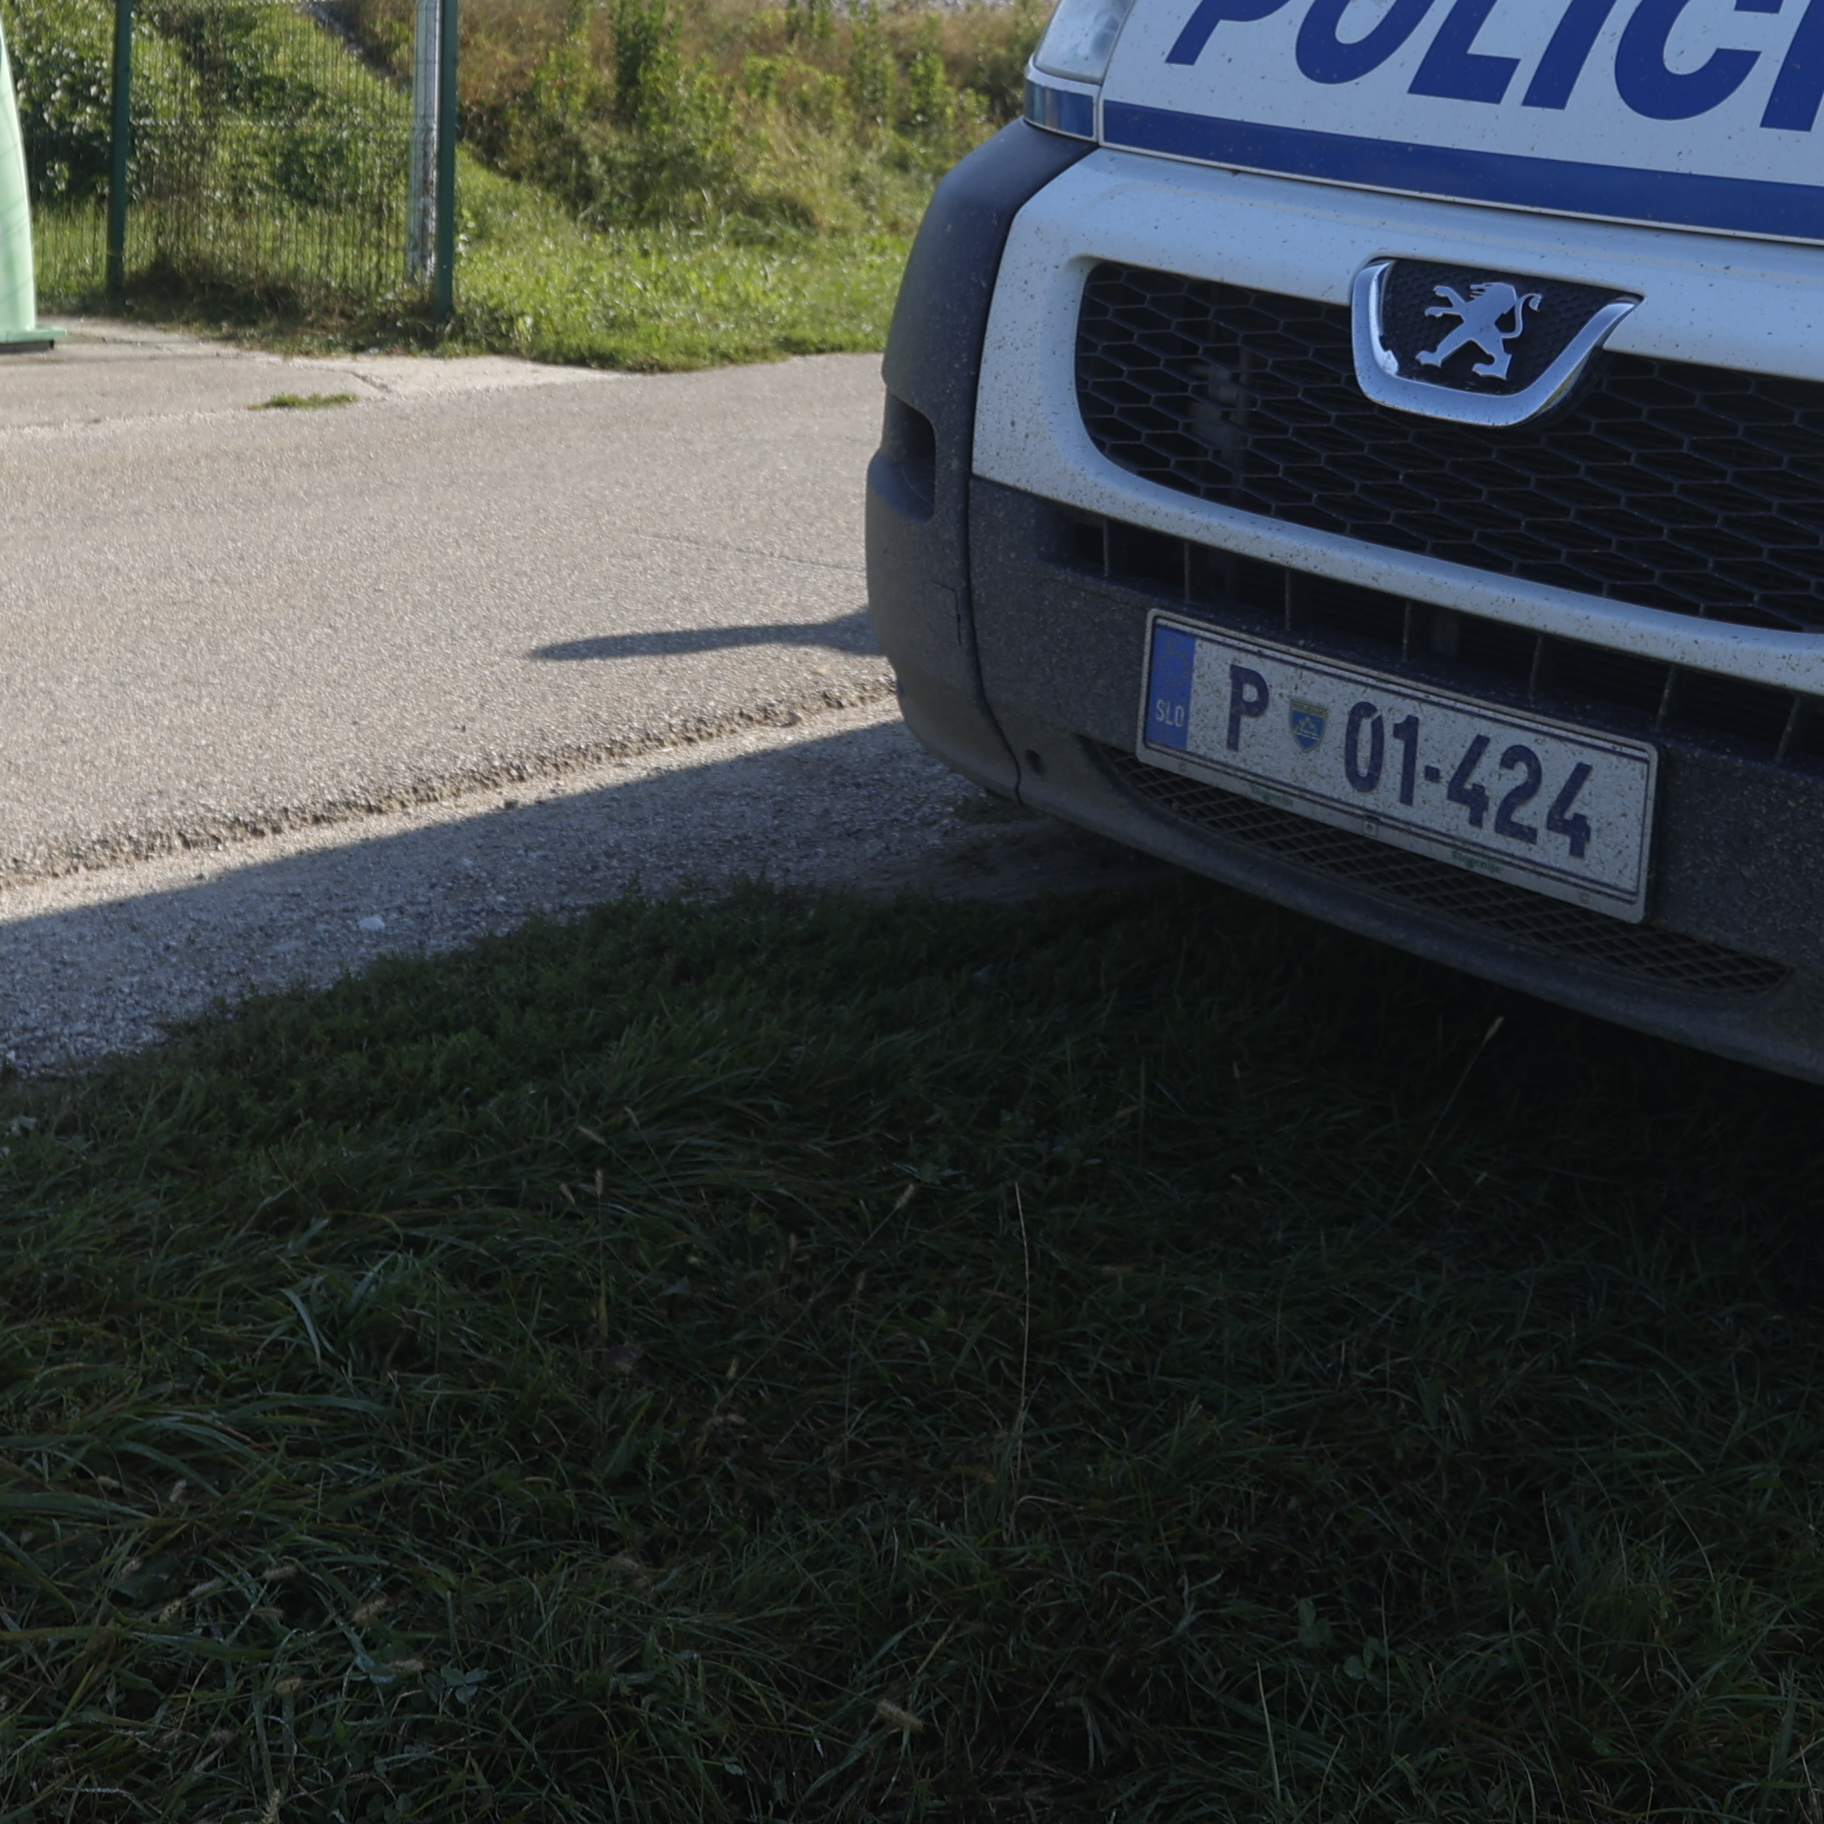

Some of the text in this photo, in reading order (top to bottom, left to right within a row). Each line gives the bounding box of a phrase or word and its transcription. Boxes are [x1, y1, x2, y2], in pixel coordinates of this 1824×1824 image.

[1155, 699, 1184, 727] SLO
[1226, 663, 1594, 860] P 01-424
